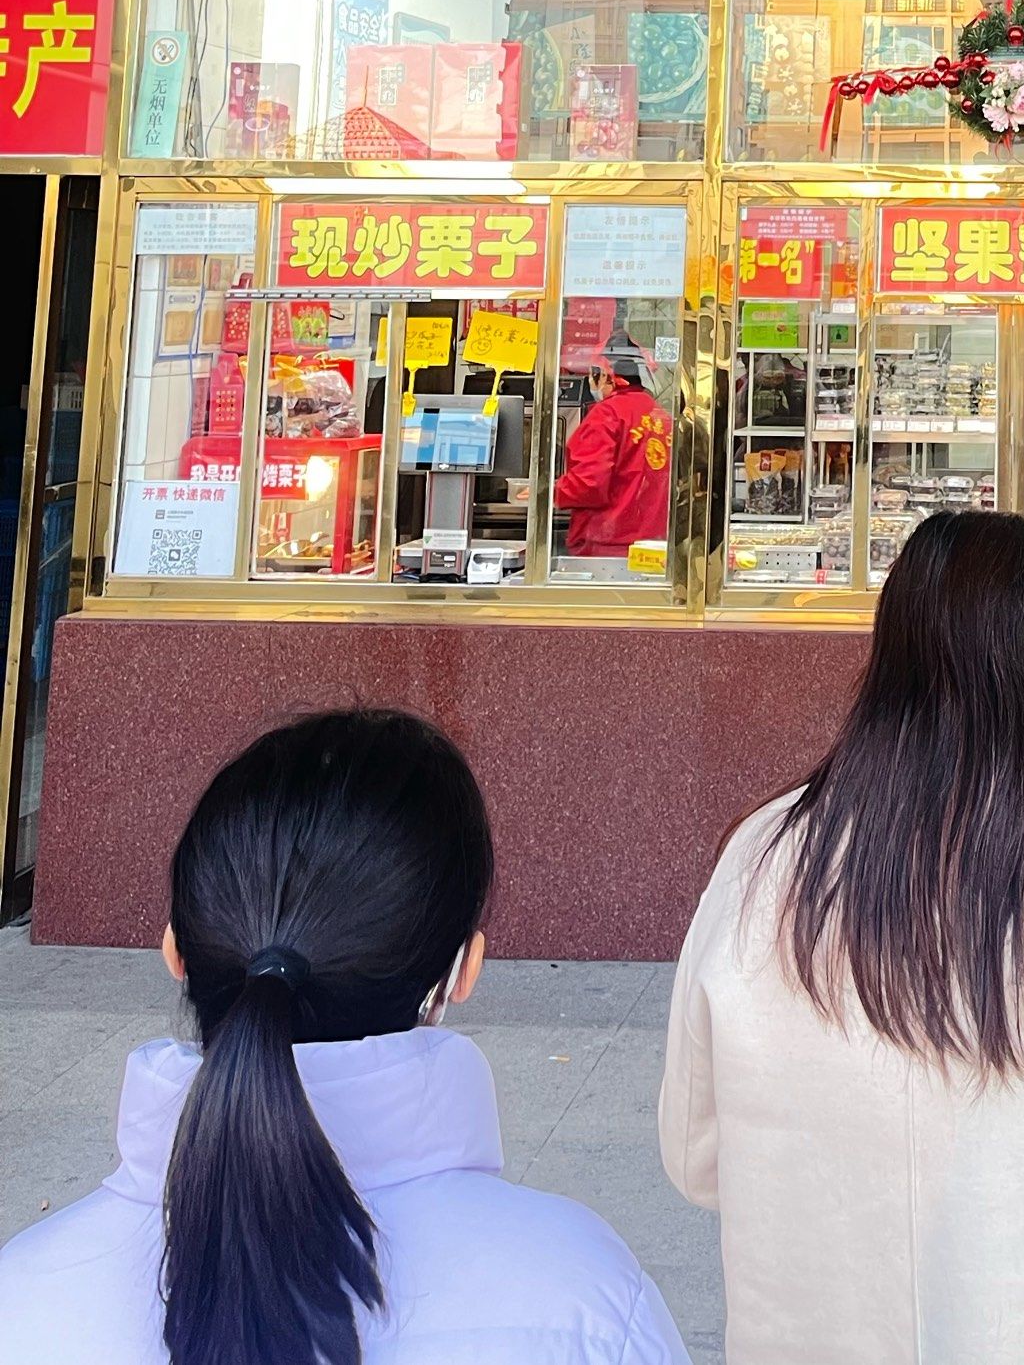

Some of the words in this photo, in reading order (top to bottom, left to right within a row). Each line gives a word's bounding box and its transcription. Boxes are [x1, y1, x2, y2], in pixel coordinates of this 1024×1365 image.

[0, 1, 95, 118] 产
[144, 78, 168, 146] 无烟单位
[289, 214, 538, 279] 现炒栗子
[142, 487, 168, 502] 开票
[173, 487, 227, 503] 快递微信
